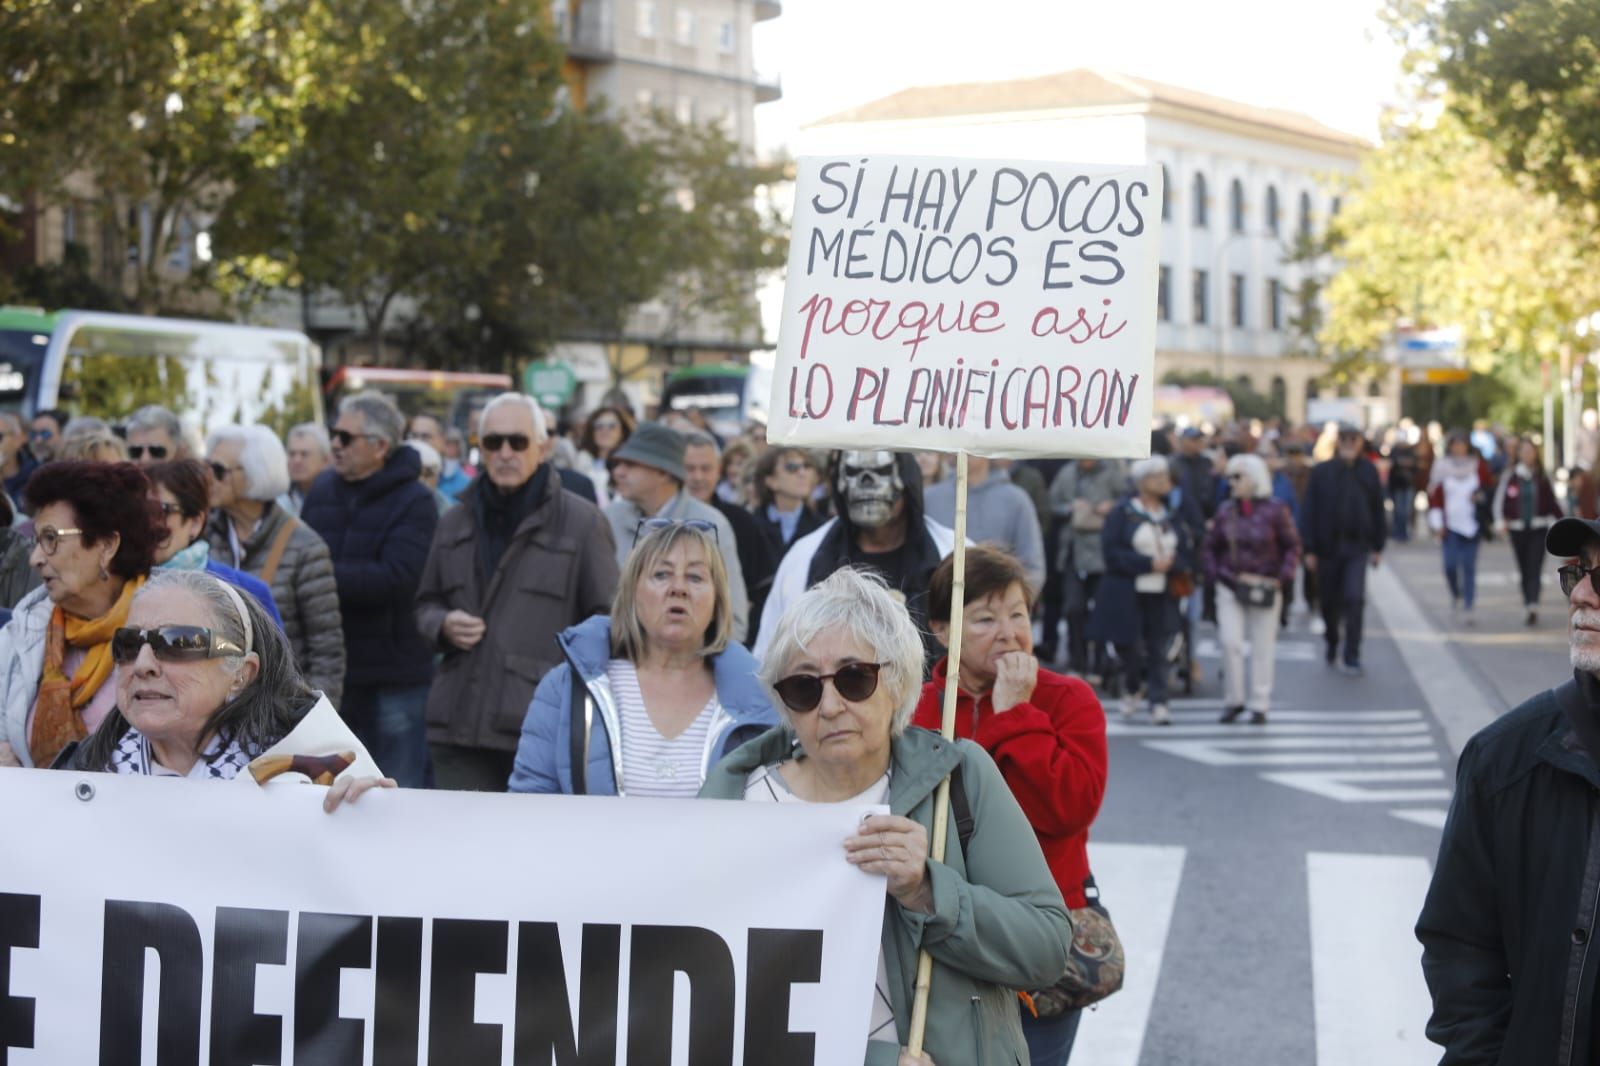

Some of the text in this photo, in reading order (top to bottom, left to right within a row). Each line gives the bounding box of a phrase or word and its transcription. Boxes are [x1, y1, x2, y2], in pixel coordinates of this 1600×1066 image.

[879, 164, 978, 234] HAY
[985, 167, 1149, 237] POCOS
[1042, 240, 1125, 290] ES
[798, 293, 1005, 362] porque
[788, 362, 834, 419] LO
